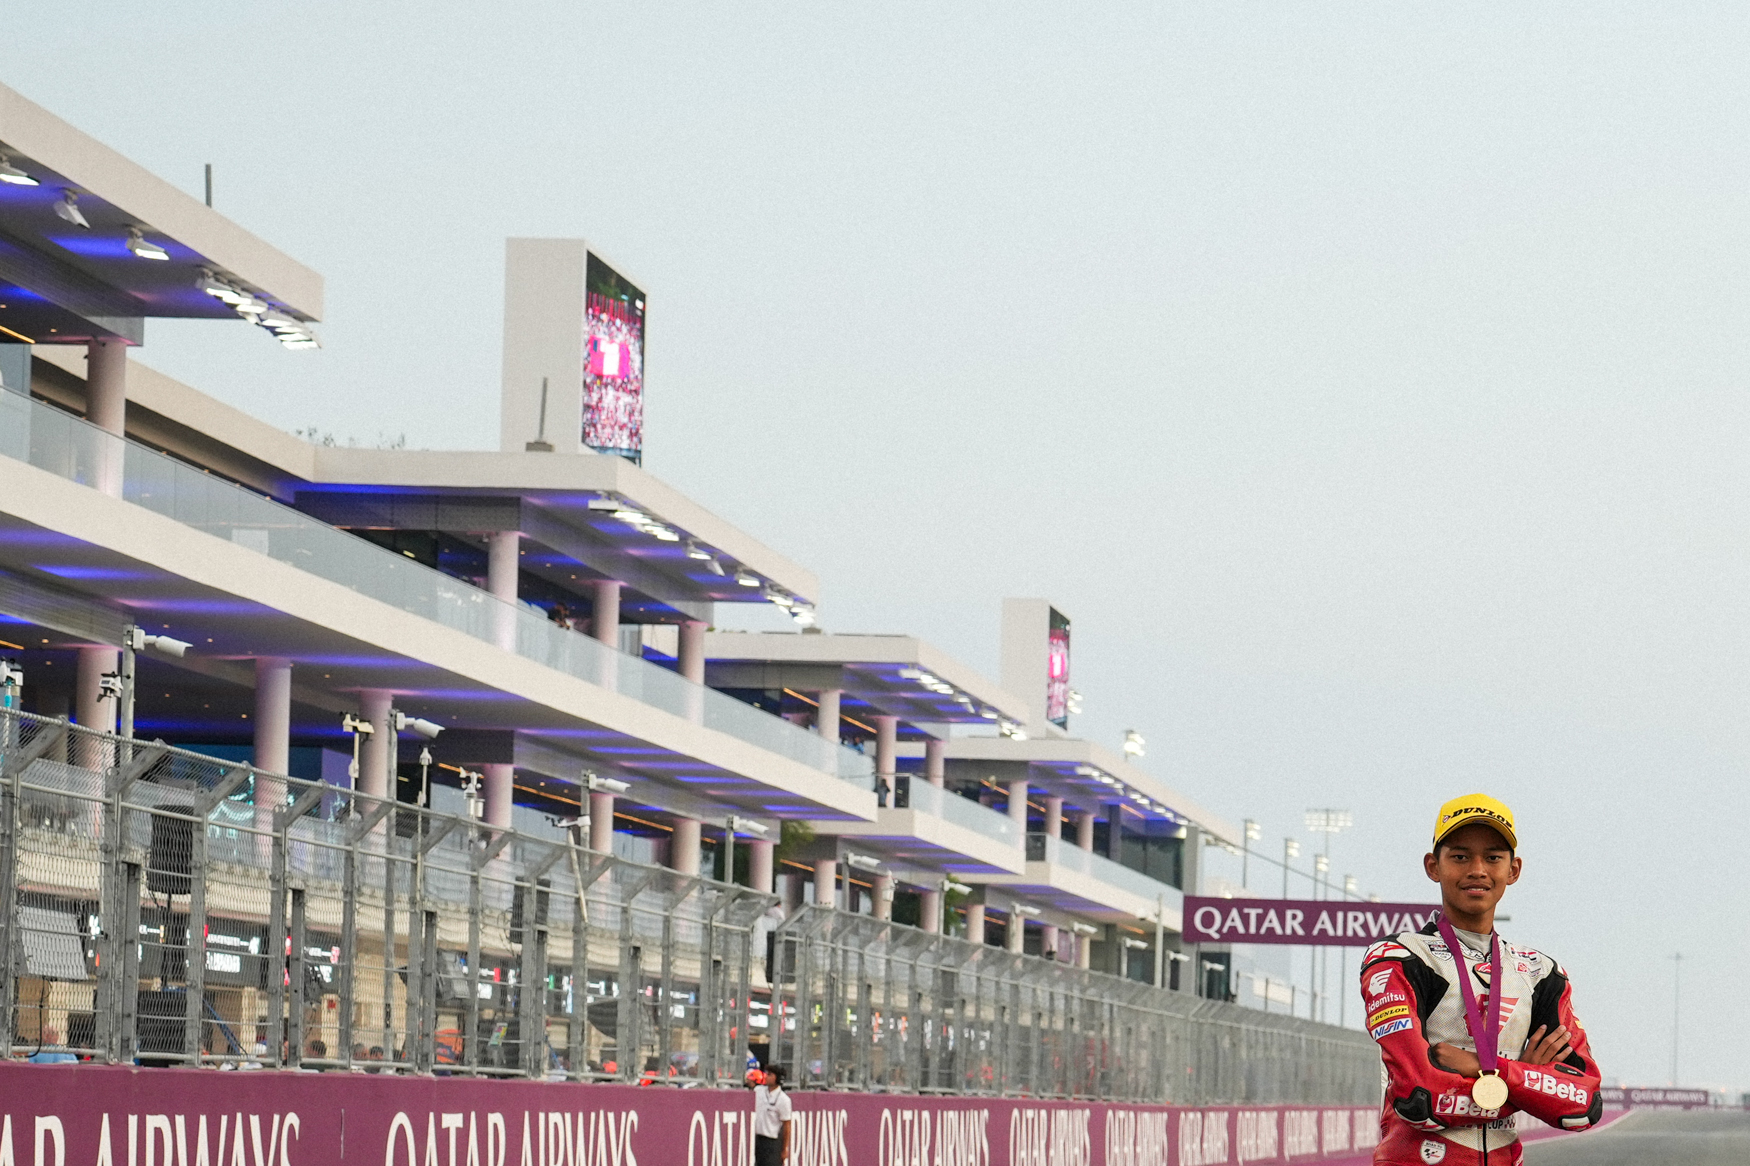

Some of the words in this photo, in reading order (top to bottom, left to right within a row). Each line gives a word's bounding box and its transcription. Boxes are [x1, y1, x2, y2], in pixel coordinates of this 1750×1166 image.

[1451, 807, 1512, 828] DUNLOP
[1194, 905, 1305, 939] QATAR
[1312, 909, 1431, 938] AIRWAY
[1368, 992, 1406, 1013] idemitsu
[1374, 1007, 1408, 1021] DUNLOP
[1542, 1074, 1588, 1106] Beta
